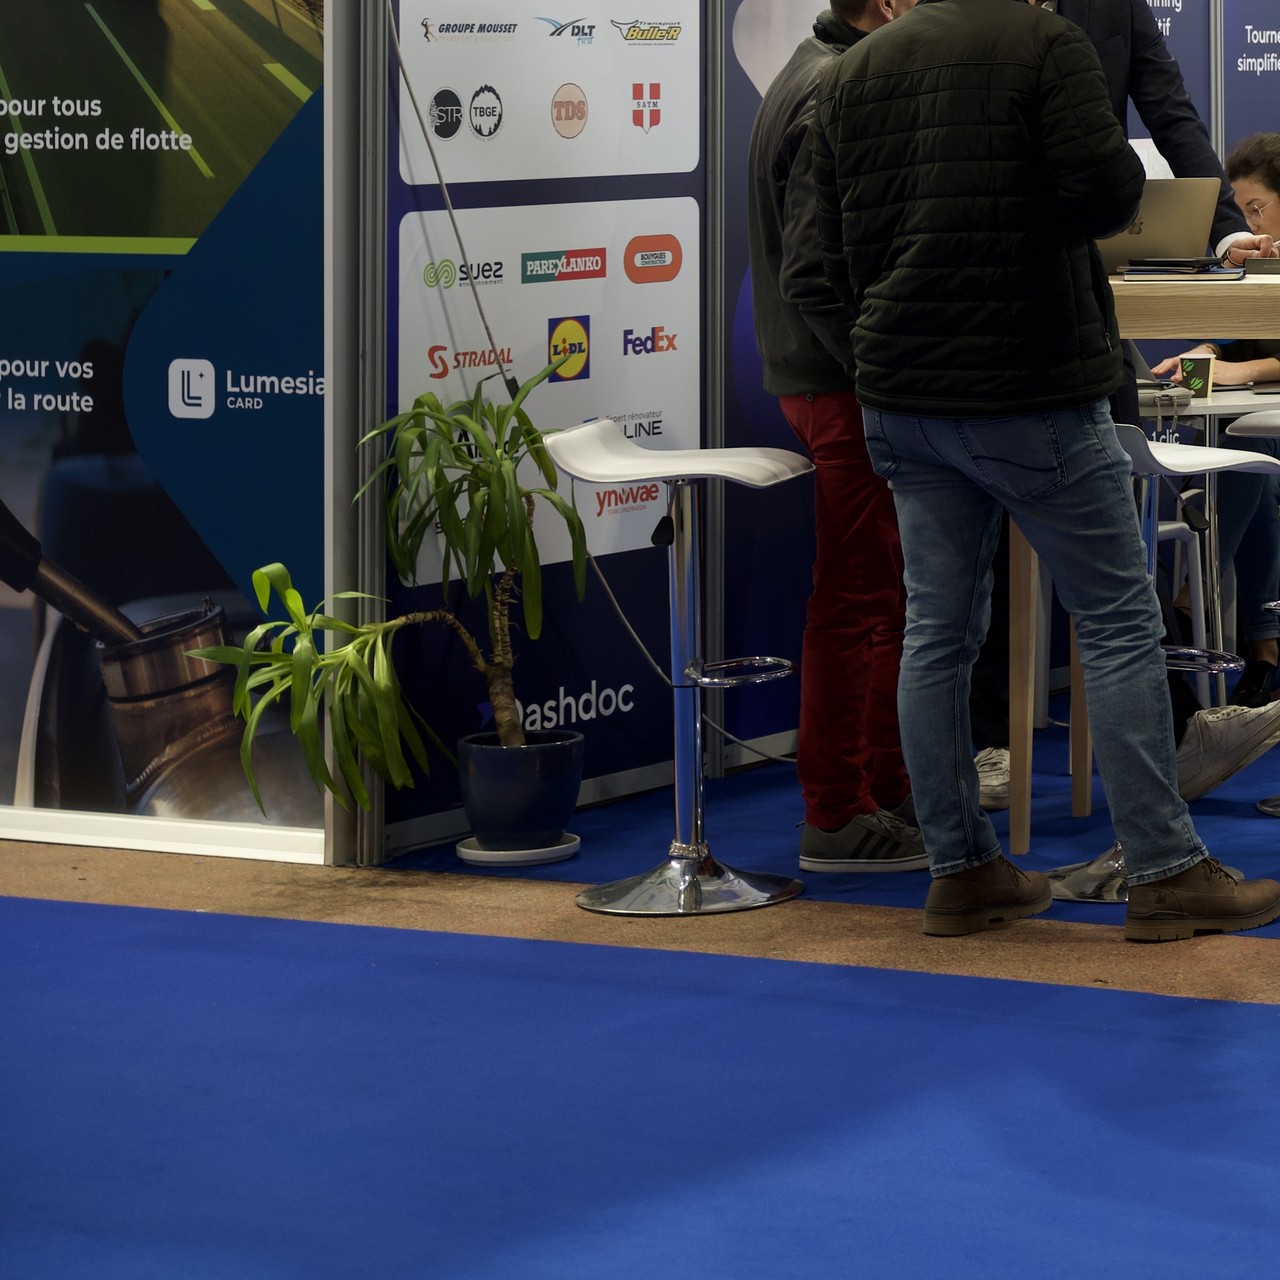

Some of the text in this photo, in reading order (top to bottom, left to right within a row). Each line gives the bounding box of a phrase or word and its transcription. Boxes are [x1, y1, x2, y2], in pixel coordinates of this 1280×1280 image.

[439, 23, 518, 33] GROUPE MOUSSET
[571, 25, 596, 37] DLT
[52, 96, 102, 116] tous
[473, 106, 497, 117] TBGE
[554, 101, 586, 121] TDS
[636, 101, 659, 109] SATM
[4, 126, 192, 155] gestion de flotte
[623, 326, 678, 356] FedEx
[453, 348, 513, 369] STRADAL
[55, 361, 94, 378] vos
[226, 370, 325, 395] Lumesia
[7, 388, 94, 412] la route
[227, 397, 263, 409] CARD
[623, 420, 662, 439] LINE
